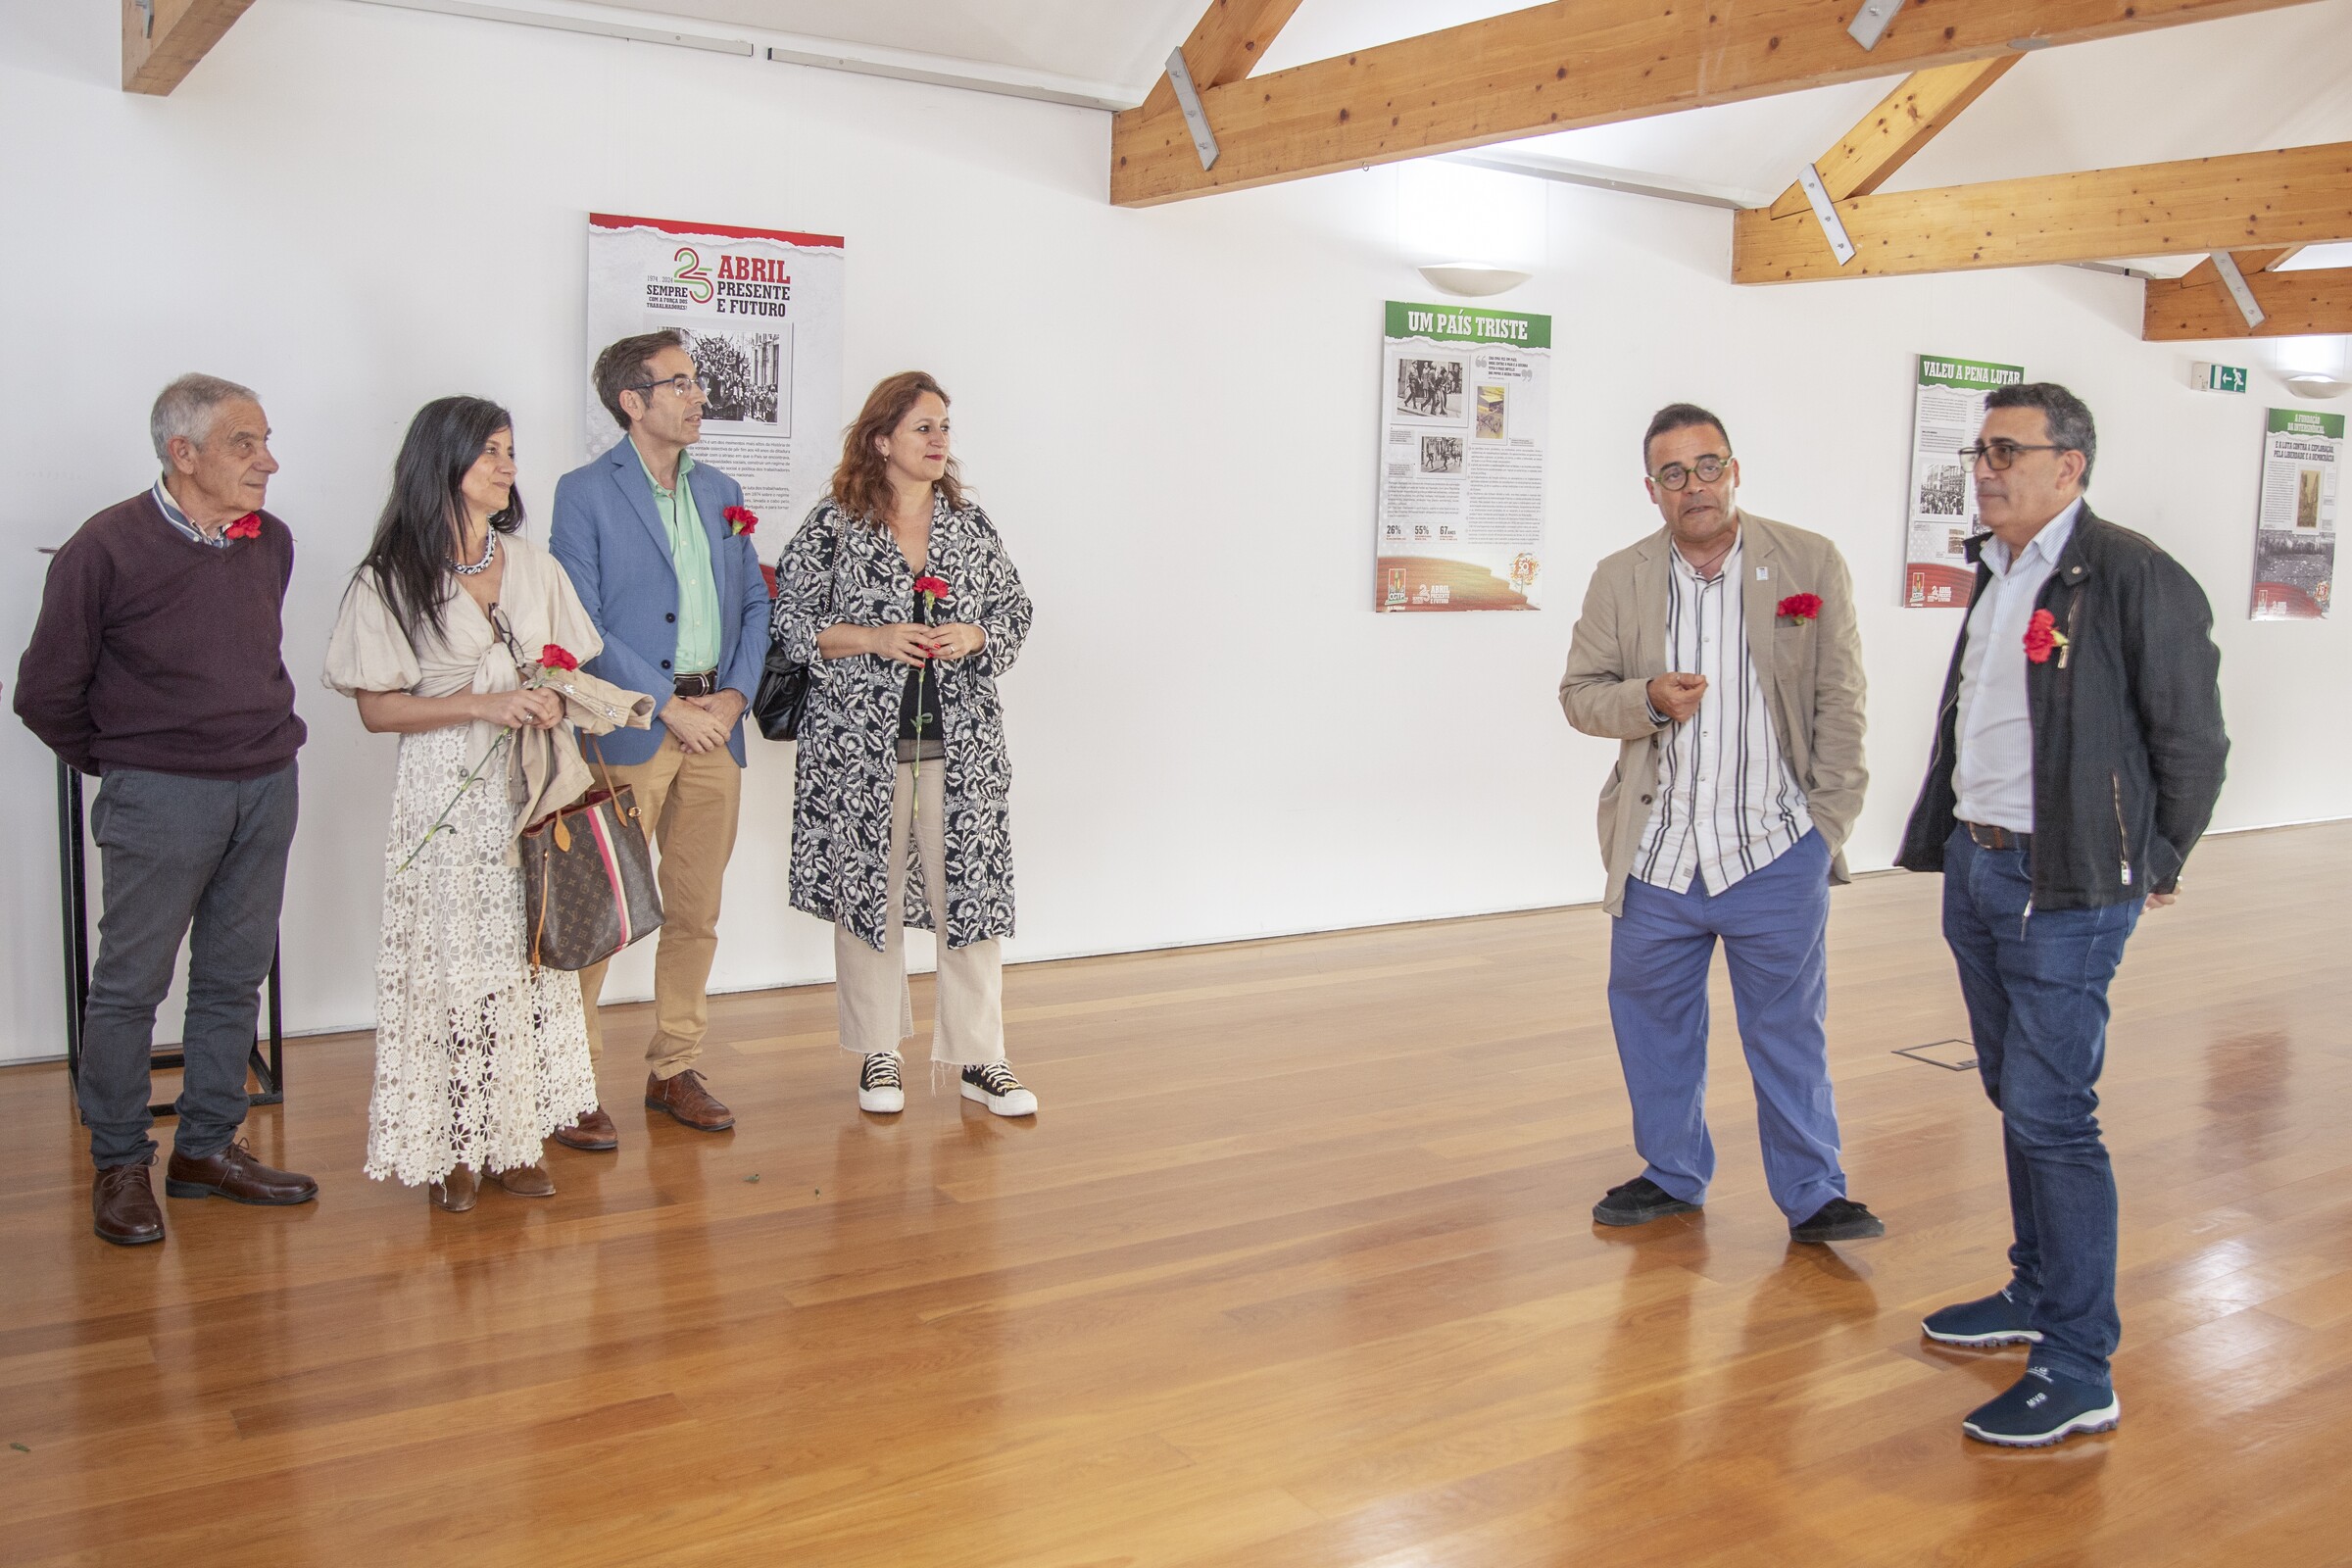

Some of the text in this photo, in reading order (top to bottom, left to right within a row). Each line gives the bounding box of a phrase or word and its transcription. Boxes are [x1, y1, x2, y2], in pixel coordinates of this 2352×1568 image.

[674, 247, 713, 304] 25
[717, 255, 791, 284] ABRIL
[647, 284, 688, 297] SEMPRE
[717, 281, 790, 301] PRESENTE
[717, 298, 786, 317] E FUTURO
[1408, 309, 1528, 340] UM PAÍS TRISTE
[1923, 361, 2021, 385] VALEU A PENA LUTAR
[1387, 525, 1401, 535] 26%
[1415, 526, 1429, 535] 55%
[1440, 526, 1448, 535] 67
